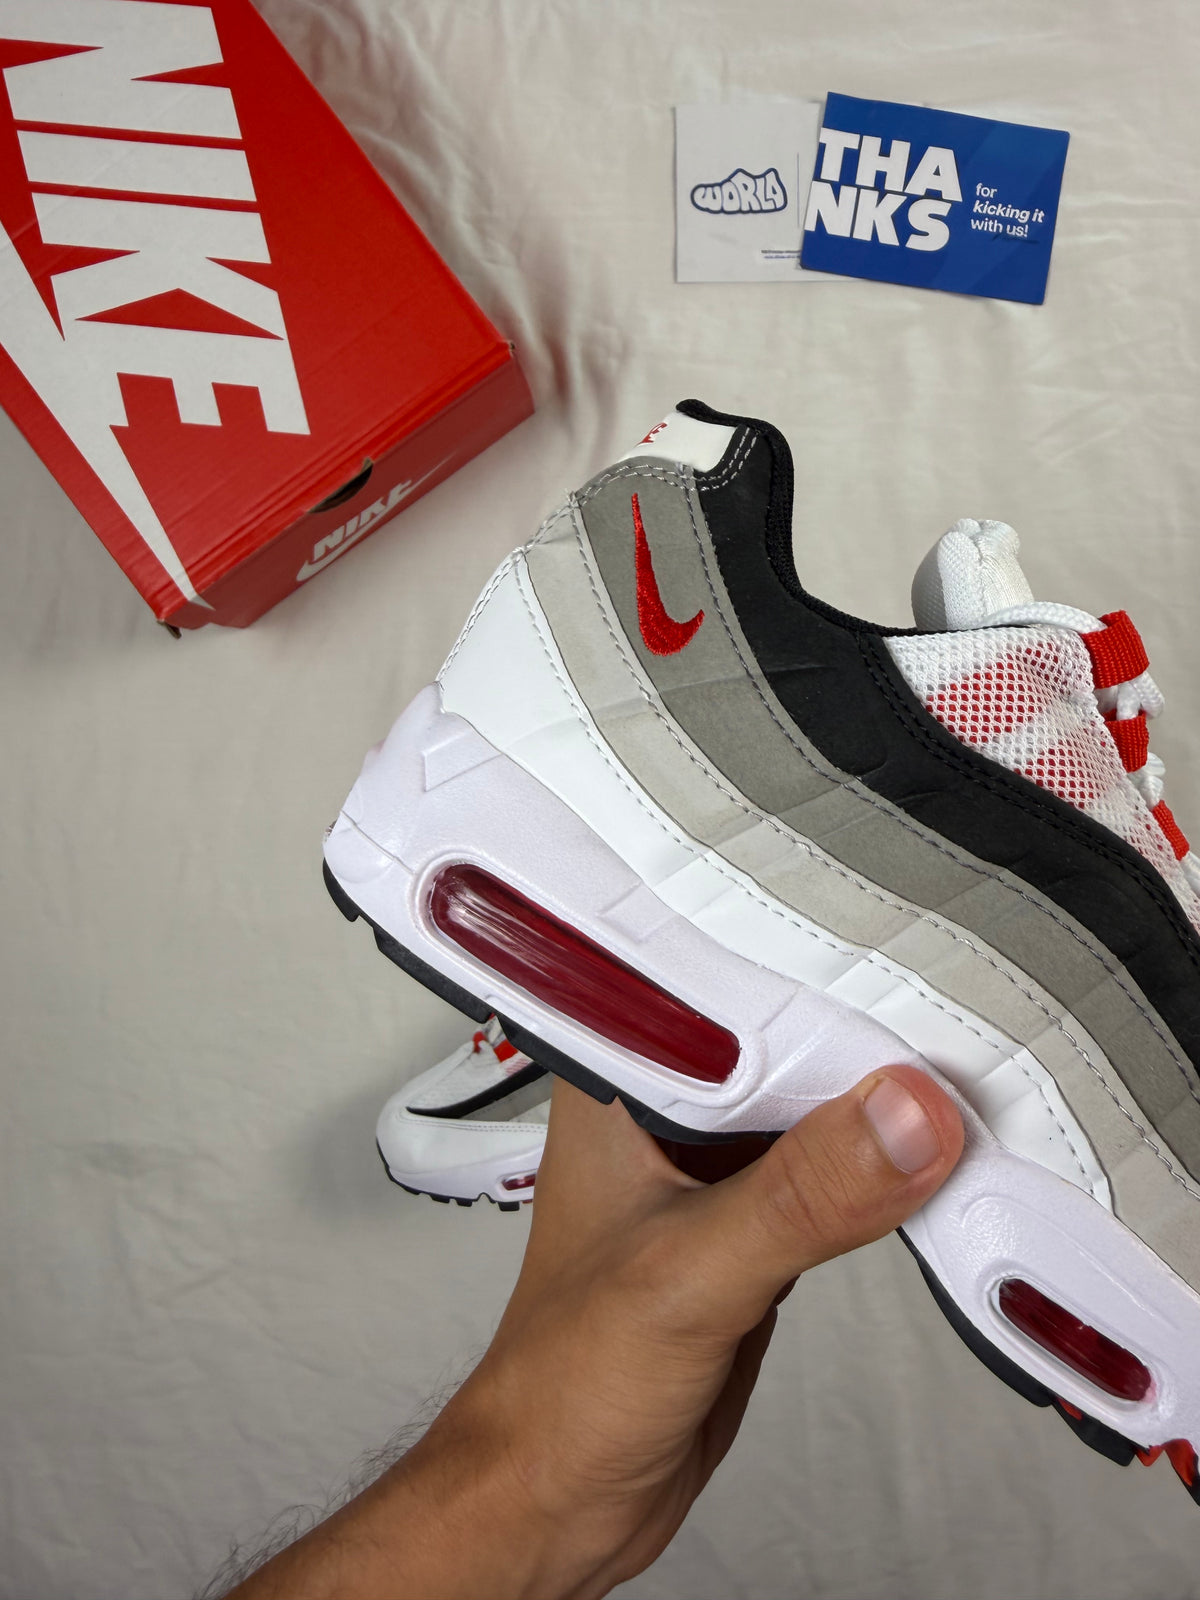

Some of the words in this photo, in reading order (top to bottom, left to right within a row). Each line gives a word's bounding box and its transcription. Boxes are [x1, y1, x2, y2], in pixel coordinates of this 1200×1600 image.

[819, 127, 963, 202] THA
[976, 182, 998, 198] for
[0, 0, 311, 436] NIKE
[804, 180, 952, 252] NKS
[970, 217, 1003, 233] with
[1006, 224, 1029, 238] us!
[973, 199, 1030, 224] kicking
[1031, 208, 1045, 223] it
[313, 479, 412, 561] NIKE
